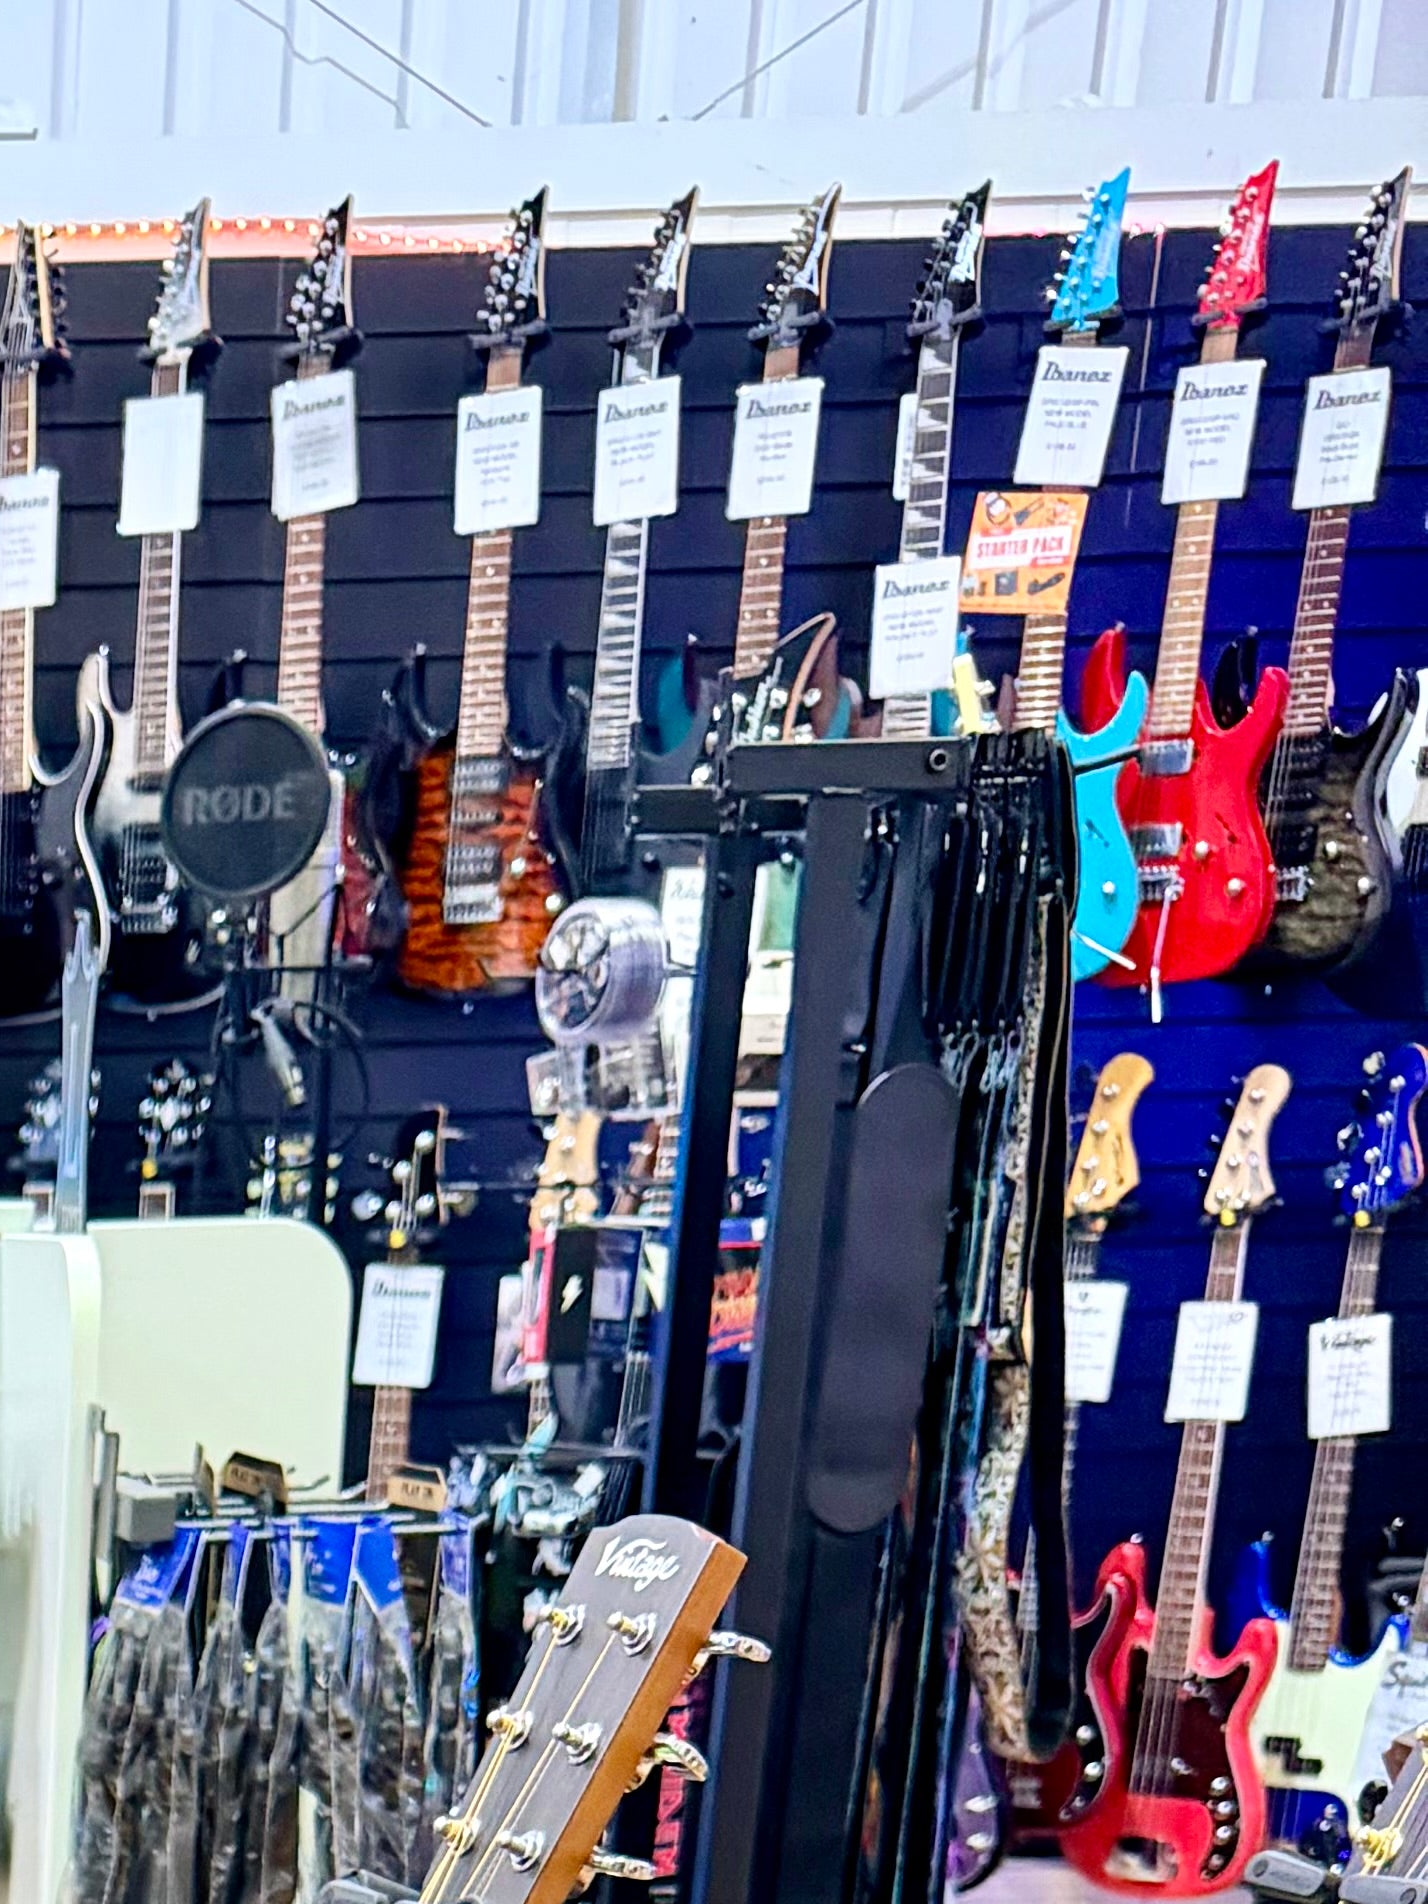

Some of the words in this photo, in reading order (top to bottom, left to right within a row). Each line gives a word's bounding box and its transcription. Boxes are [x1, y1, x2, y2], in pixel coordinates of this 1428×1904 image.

[1040, 360, 1113, 384] Ibanez
[1179, 380, 1250, 402] Ibanez
[976, 537, 1028, 560] STARTER
[1033, 534, 1064, 554] PACK
[594, 1535, 681, 1593] Vintage
